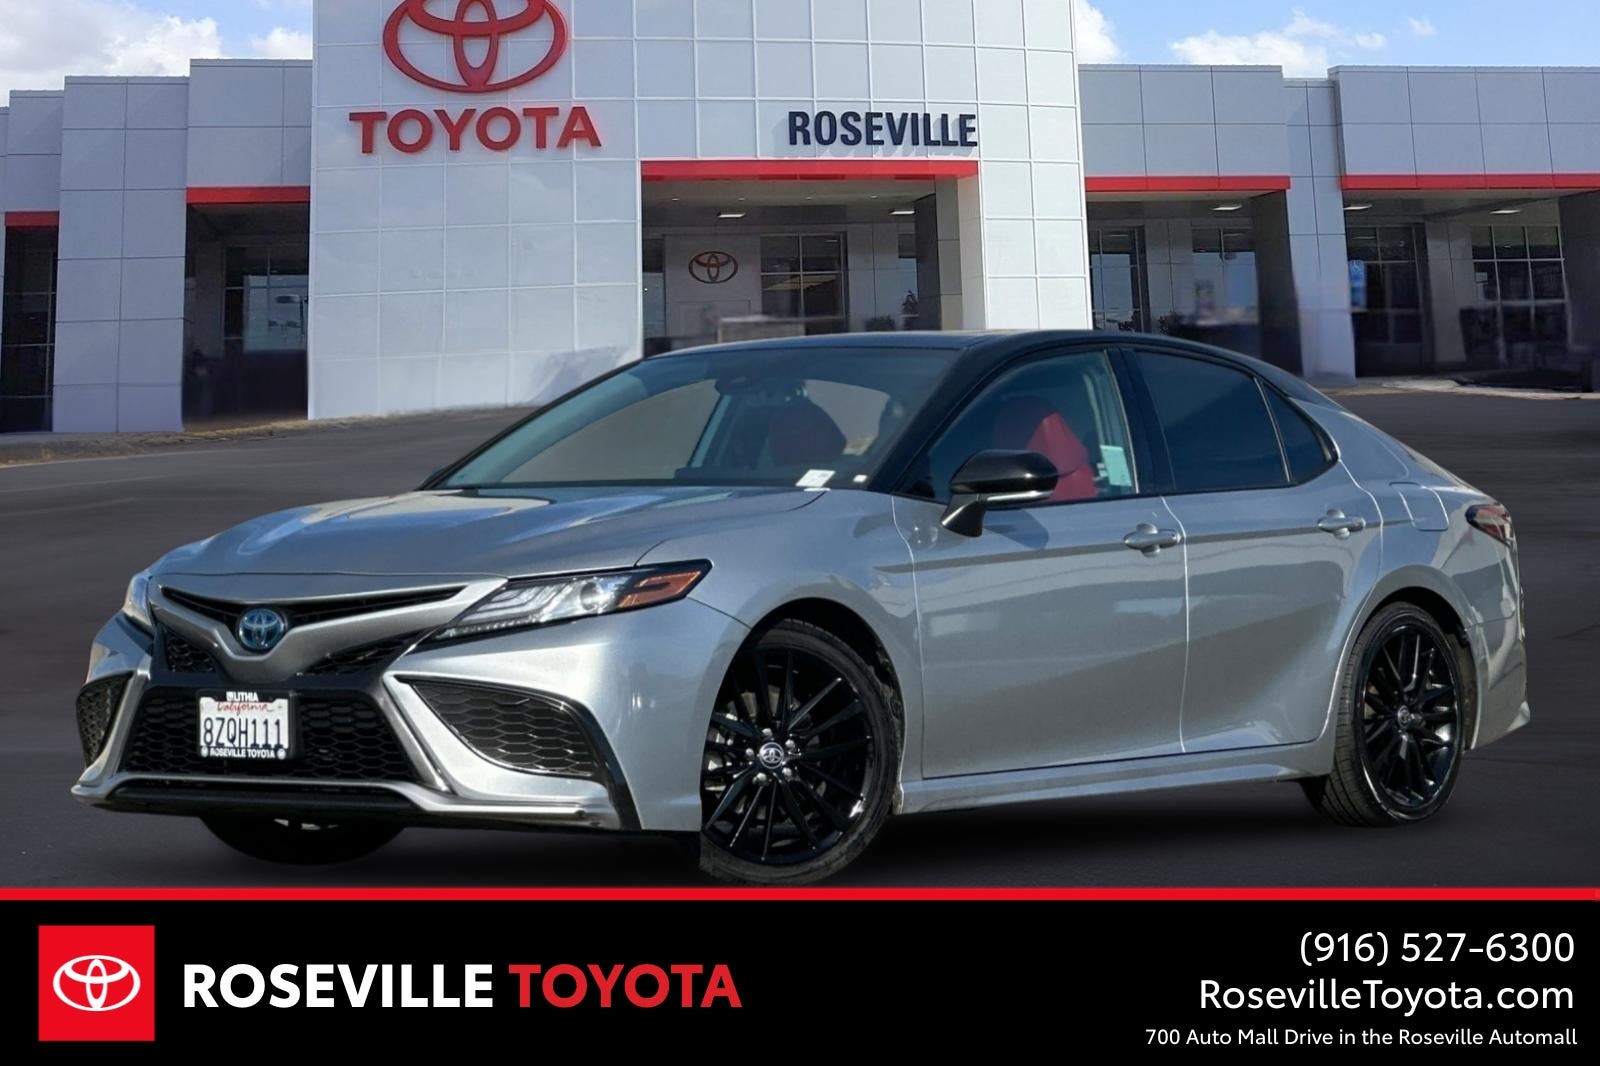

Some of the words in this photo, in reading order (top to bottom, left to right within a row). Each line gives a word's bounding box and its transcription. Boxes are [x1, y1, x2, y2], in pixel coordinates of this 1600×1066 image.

[349, 106, 602, 154] TOYOTA
[788, 110, 978, 147] ROSEVILLE
[234, 691, 260, 702] LITHIA
[217, 702, 274, 714] California
[203, 717, 284, 749] 8ZQH111
[209, 748, 246, 758] ROSEVILLE
[247, 748, 276, 759] TOYOTA
